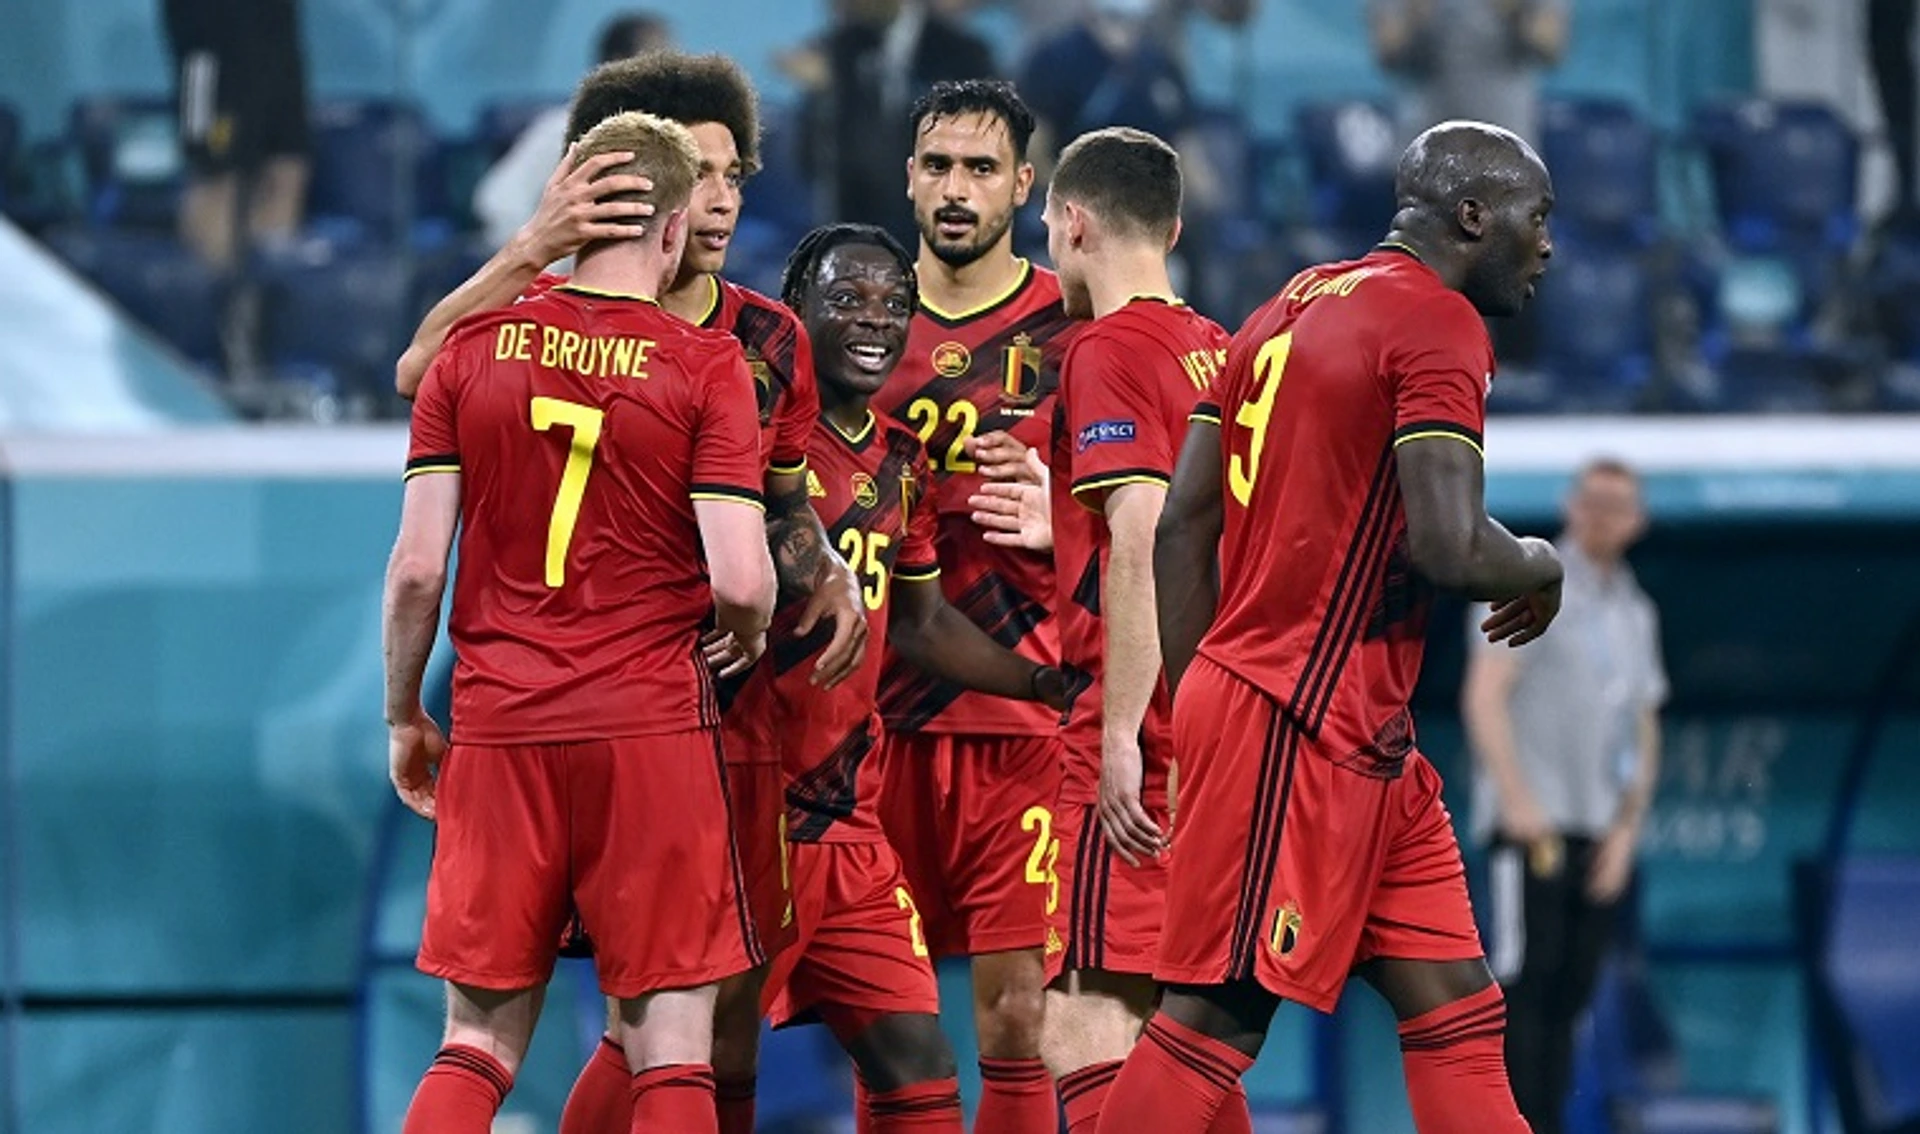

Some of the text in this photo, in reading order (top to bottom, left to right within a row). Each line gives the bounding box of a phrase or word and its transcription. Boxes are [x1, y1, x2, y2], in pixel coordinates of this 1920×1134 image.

[495, 322, 657, 380] DE BRUYNE
[907, 397, 980, 473] 22
[1229, 331, 1293, 508] 9
[530, 396, 605, 588] 7
[838, 527, 891, 611] 25
